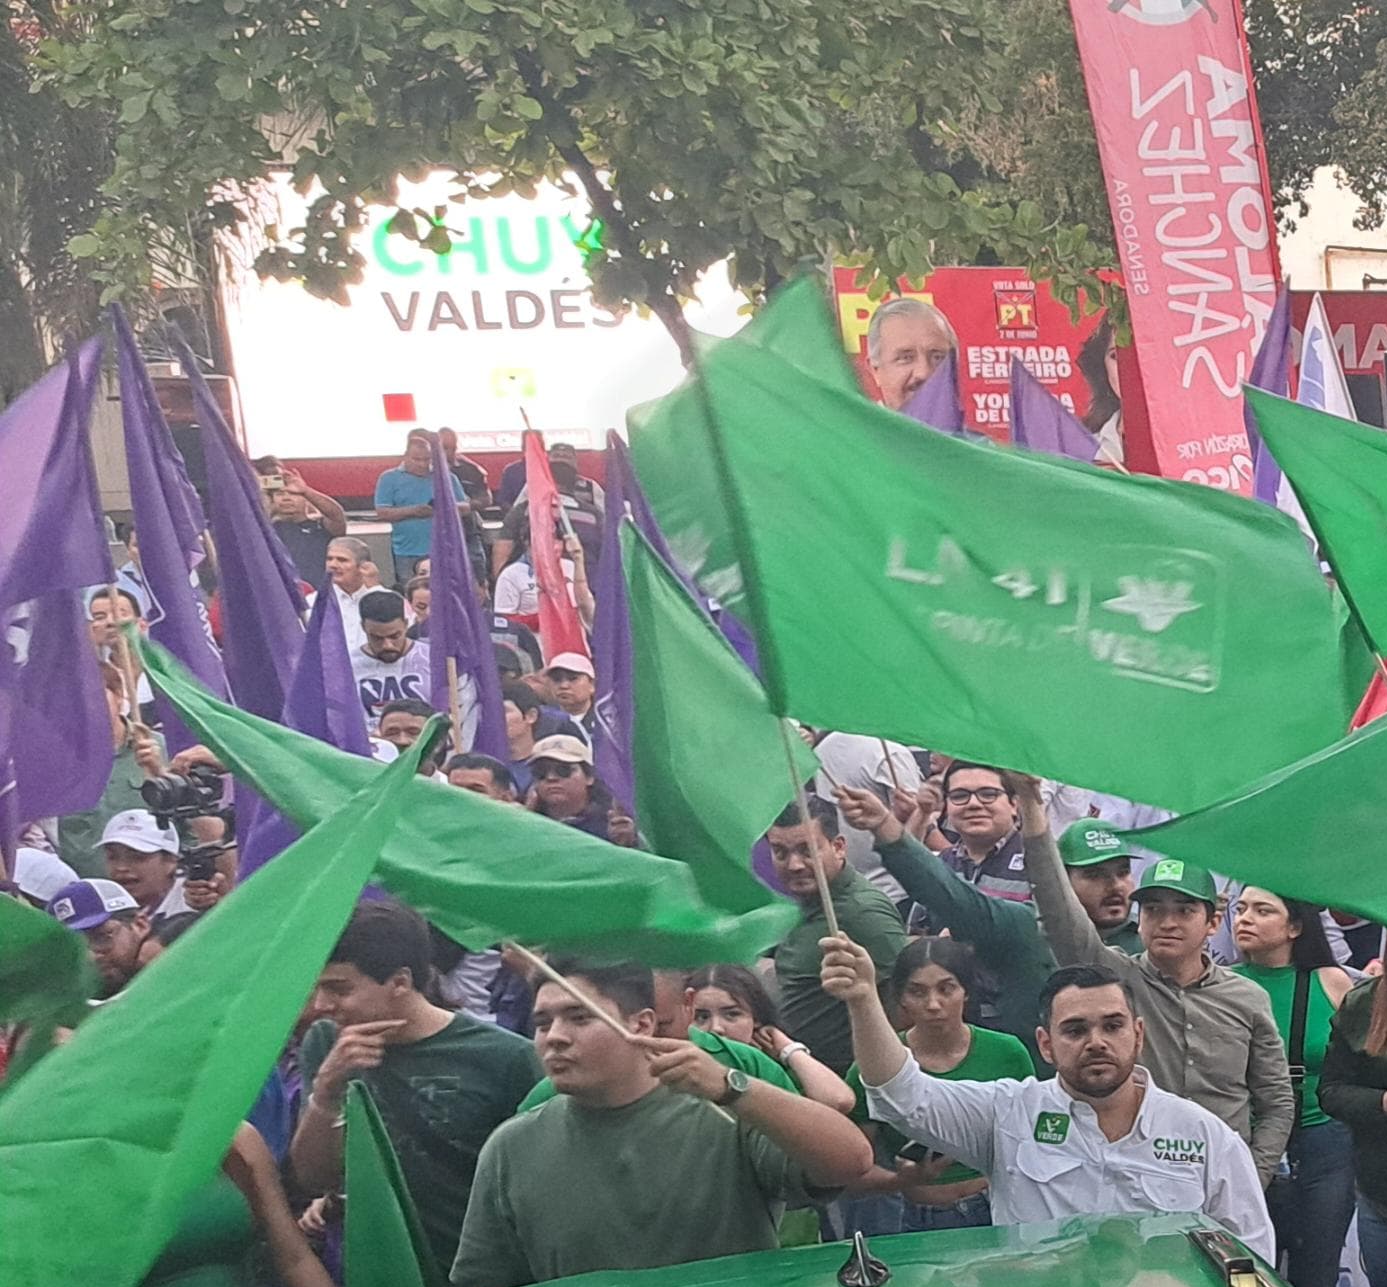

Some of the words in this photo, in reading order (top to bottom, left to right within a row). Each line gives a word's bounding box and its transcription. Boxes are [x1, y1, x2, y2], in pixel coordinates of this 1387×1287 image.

[373, 215, 606, 277] CHUY
[999, 304, 1033, 328] PT
[969, 362, 1073, 379] FEREIRO
[1153, 1138, 1206, 1154] CHUY
[1153, 1151, 1206, 1165] VALDÉS
